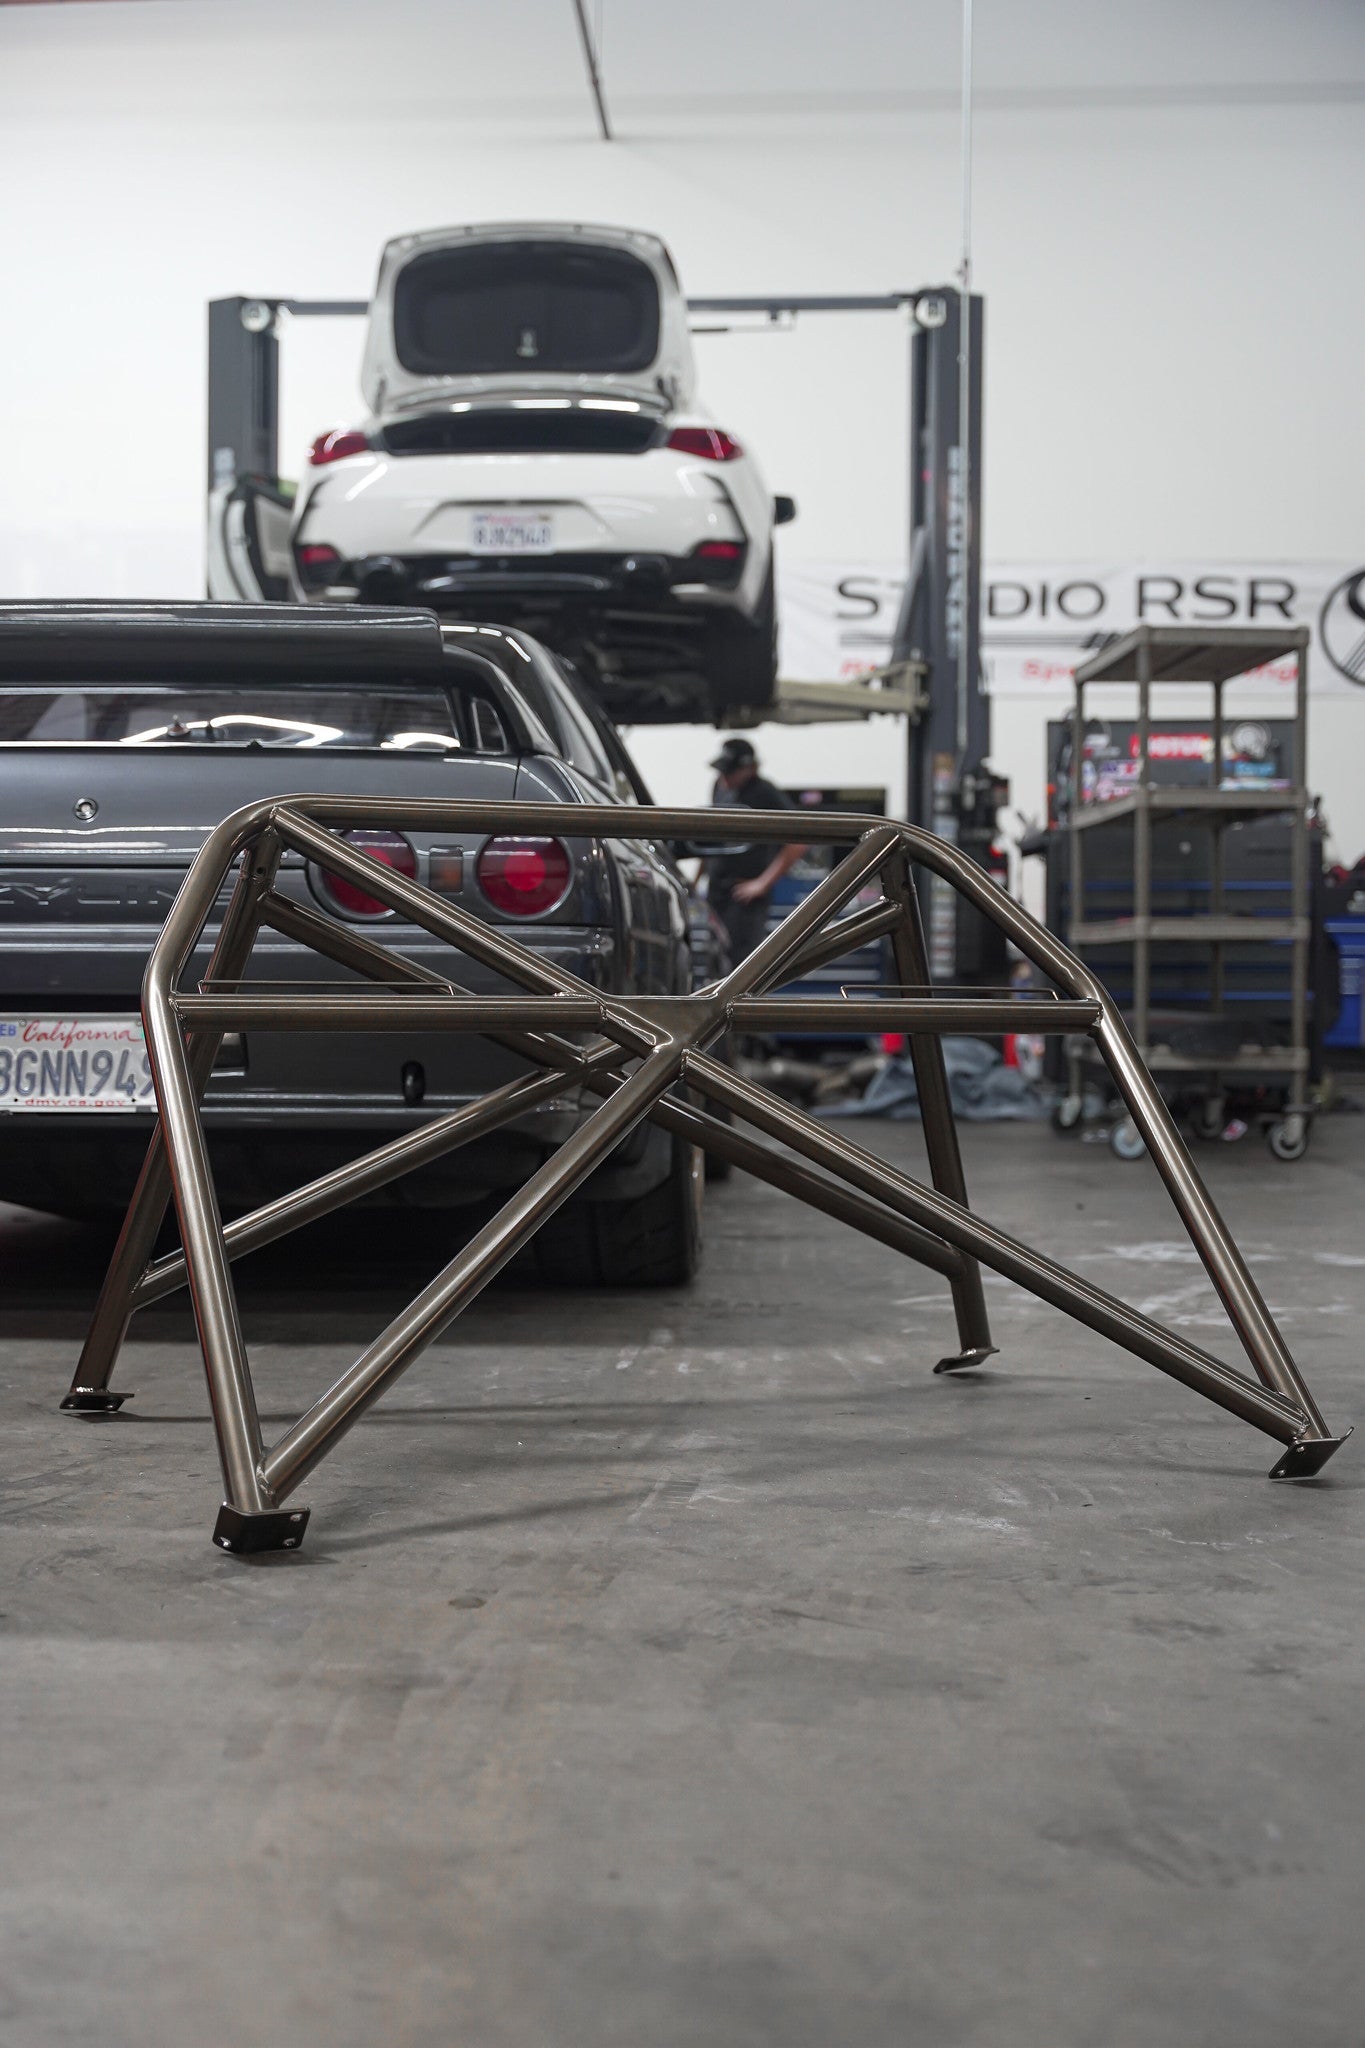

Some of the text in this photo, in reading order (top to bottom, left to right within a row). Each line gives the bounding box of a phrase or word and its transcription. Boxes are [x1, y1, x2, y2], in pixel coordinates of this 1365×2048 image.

[836, 576, 1106, 620] SDIO
[1137, 576, 1297, 620] RSR
[23, 1019, 144, 1049] California
[25, 1099, 126, 1107] dmv.ca.gov
